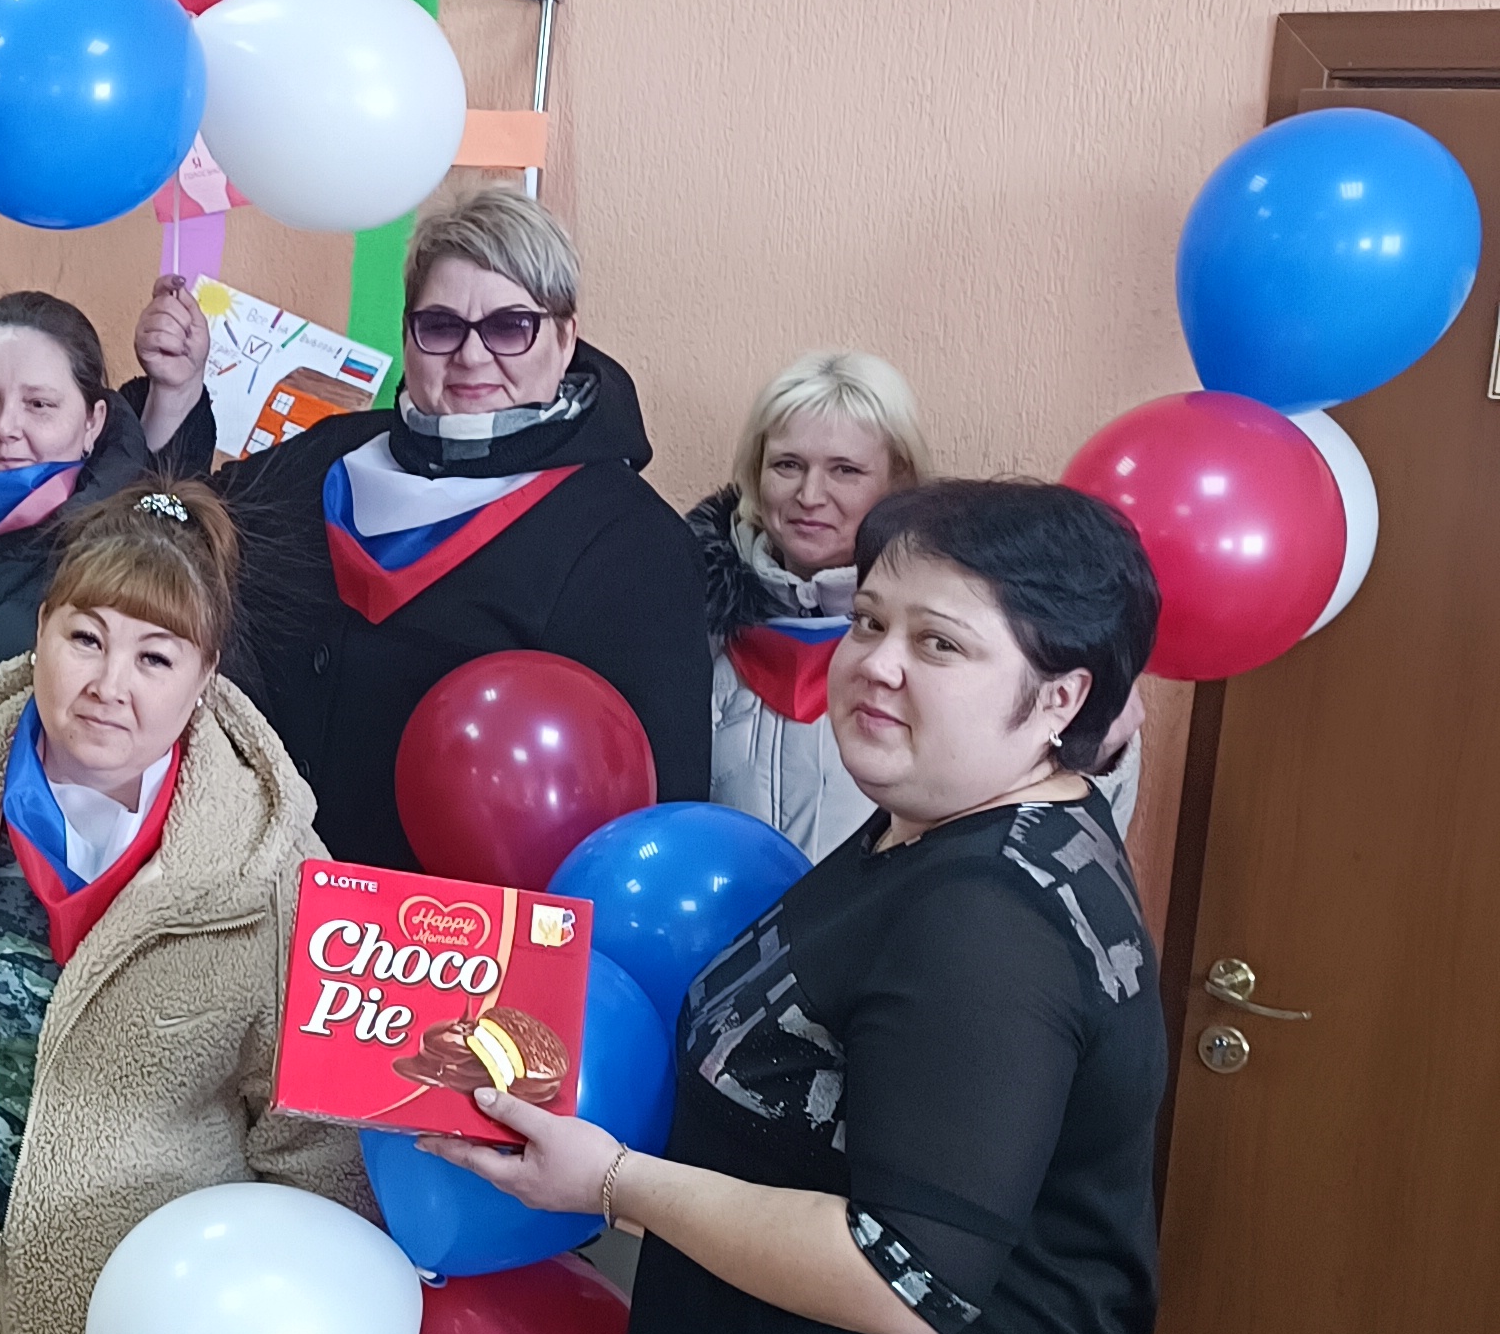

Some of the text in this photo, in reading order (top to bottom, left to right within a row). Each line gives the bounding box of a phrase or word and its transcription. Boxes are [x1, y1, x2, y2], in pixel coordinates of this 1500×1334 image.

[330, 874, 378, 893] LOTTE
[411, 908, 477, 934] Happy
[412, 928, 469, 946] Moments
[308, 919, 499, 995] Choco
[299, 979, 412, 1045] Pie
